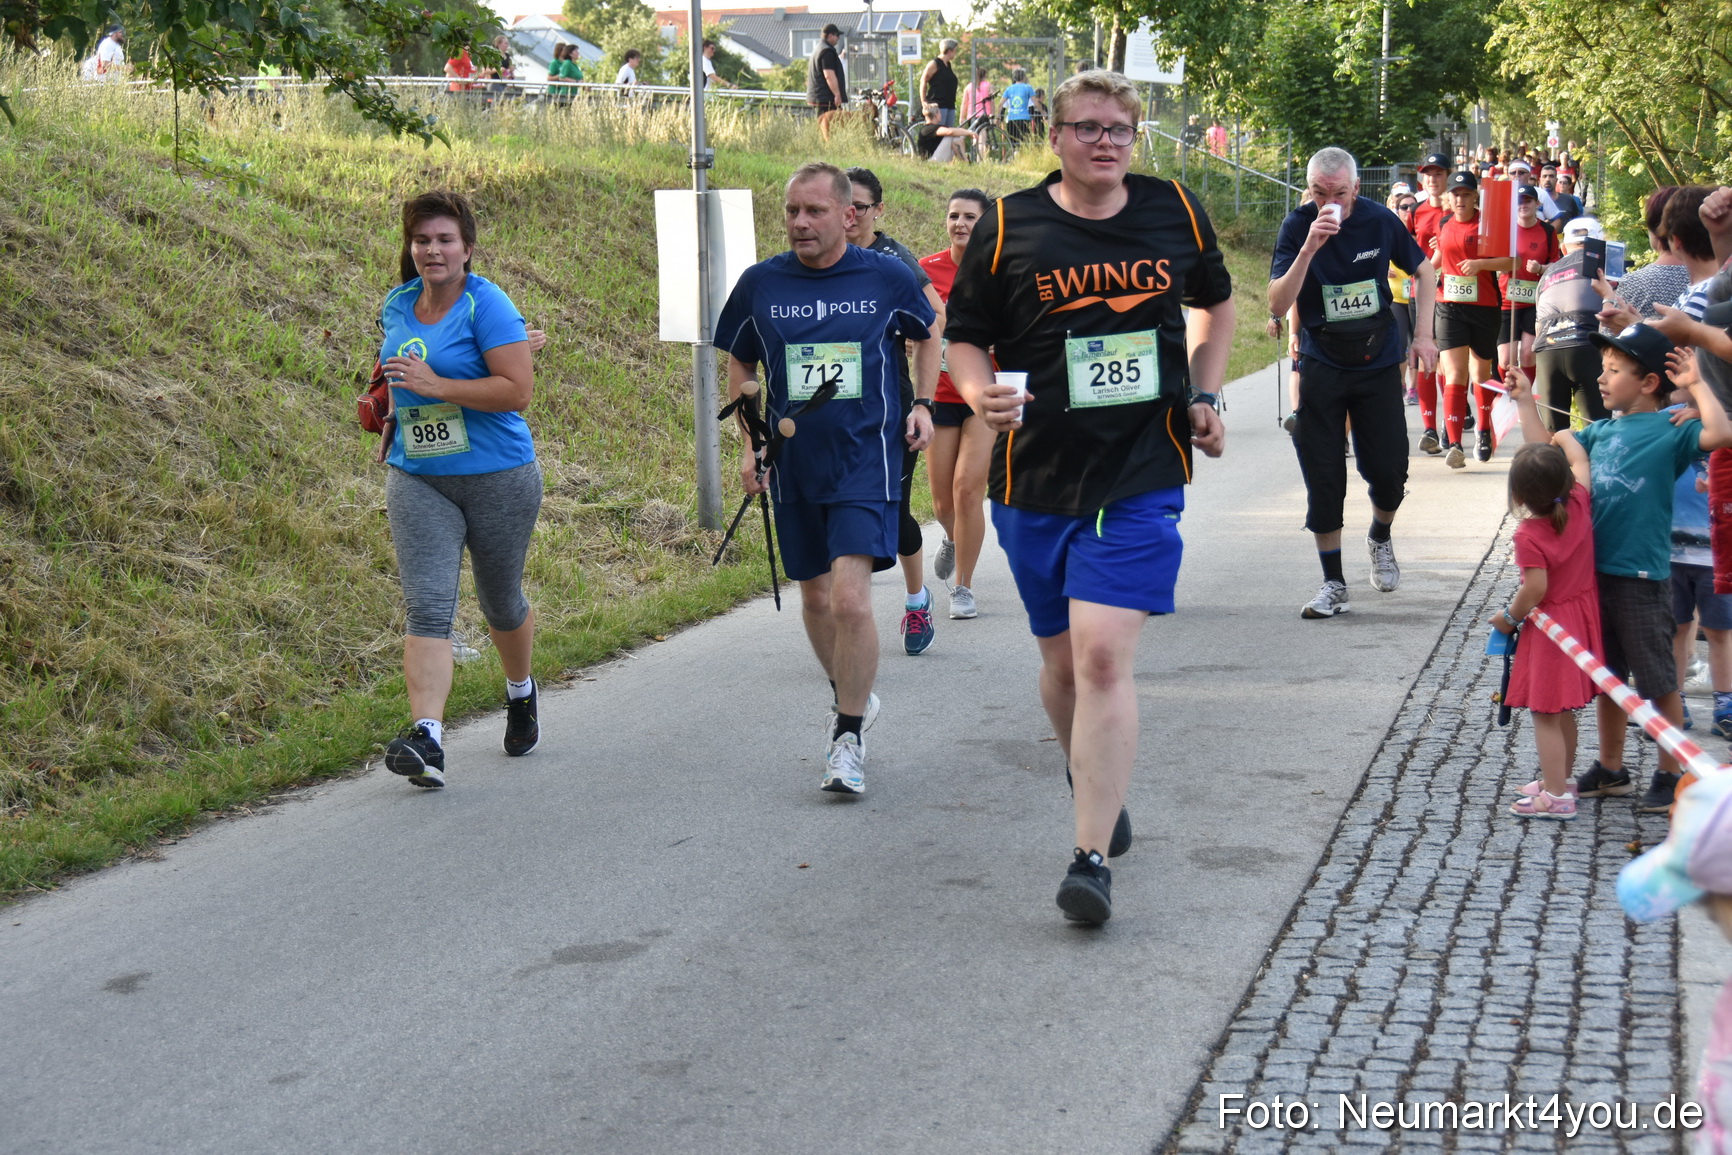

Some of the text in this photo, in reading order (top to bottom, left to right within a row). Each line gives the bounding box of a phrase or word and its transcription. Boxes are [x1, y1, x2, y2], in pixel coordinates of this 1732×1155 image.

[1036, 259, 1172, 302] BIT WINGS
[1447, 284, 1472, 295] 2356
[770, 301, 877, 318] EURO POLES
[1331, 295, 1372, 312] 1444
[801, 363, 844, 385] 712
[1089, 358, 1141, 387] 285
[1092, 384, 1141, 395] Larisch Oliver
[412, 422, 450, 444] 988
